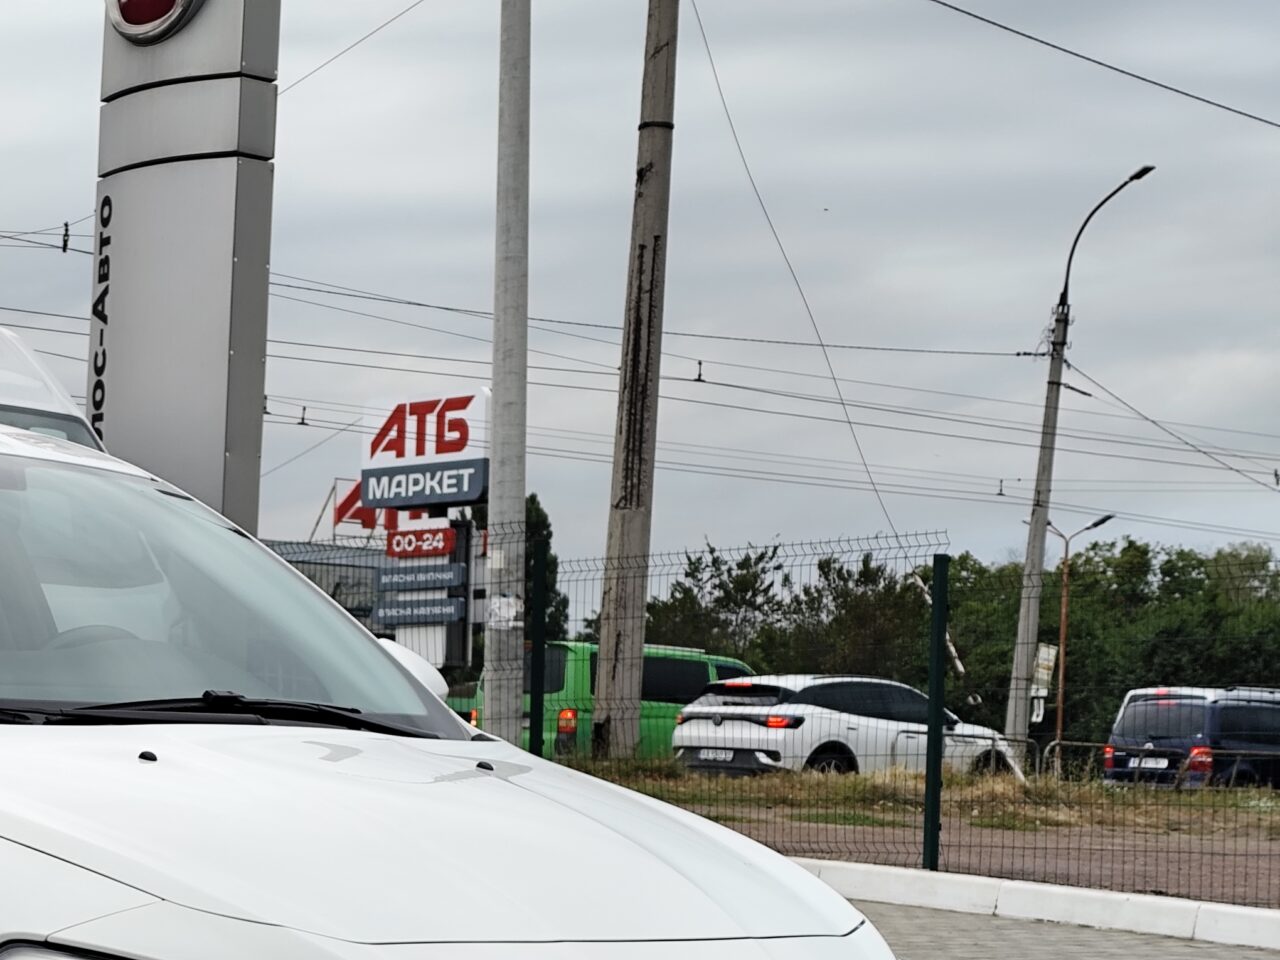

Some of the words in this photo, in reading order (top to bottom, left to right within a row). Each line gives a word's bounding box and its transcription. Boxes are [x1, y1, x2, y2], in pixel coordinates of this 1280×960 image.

[370, 395, 476, 460] АТБ
[368, 468, 475, 500] МАРКЕТ
[392, 532, 445, 552] 00-24
